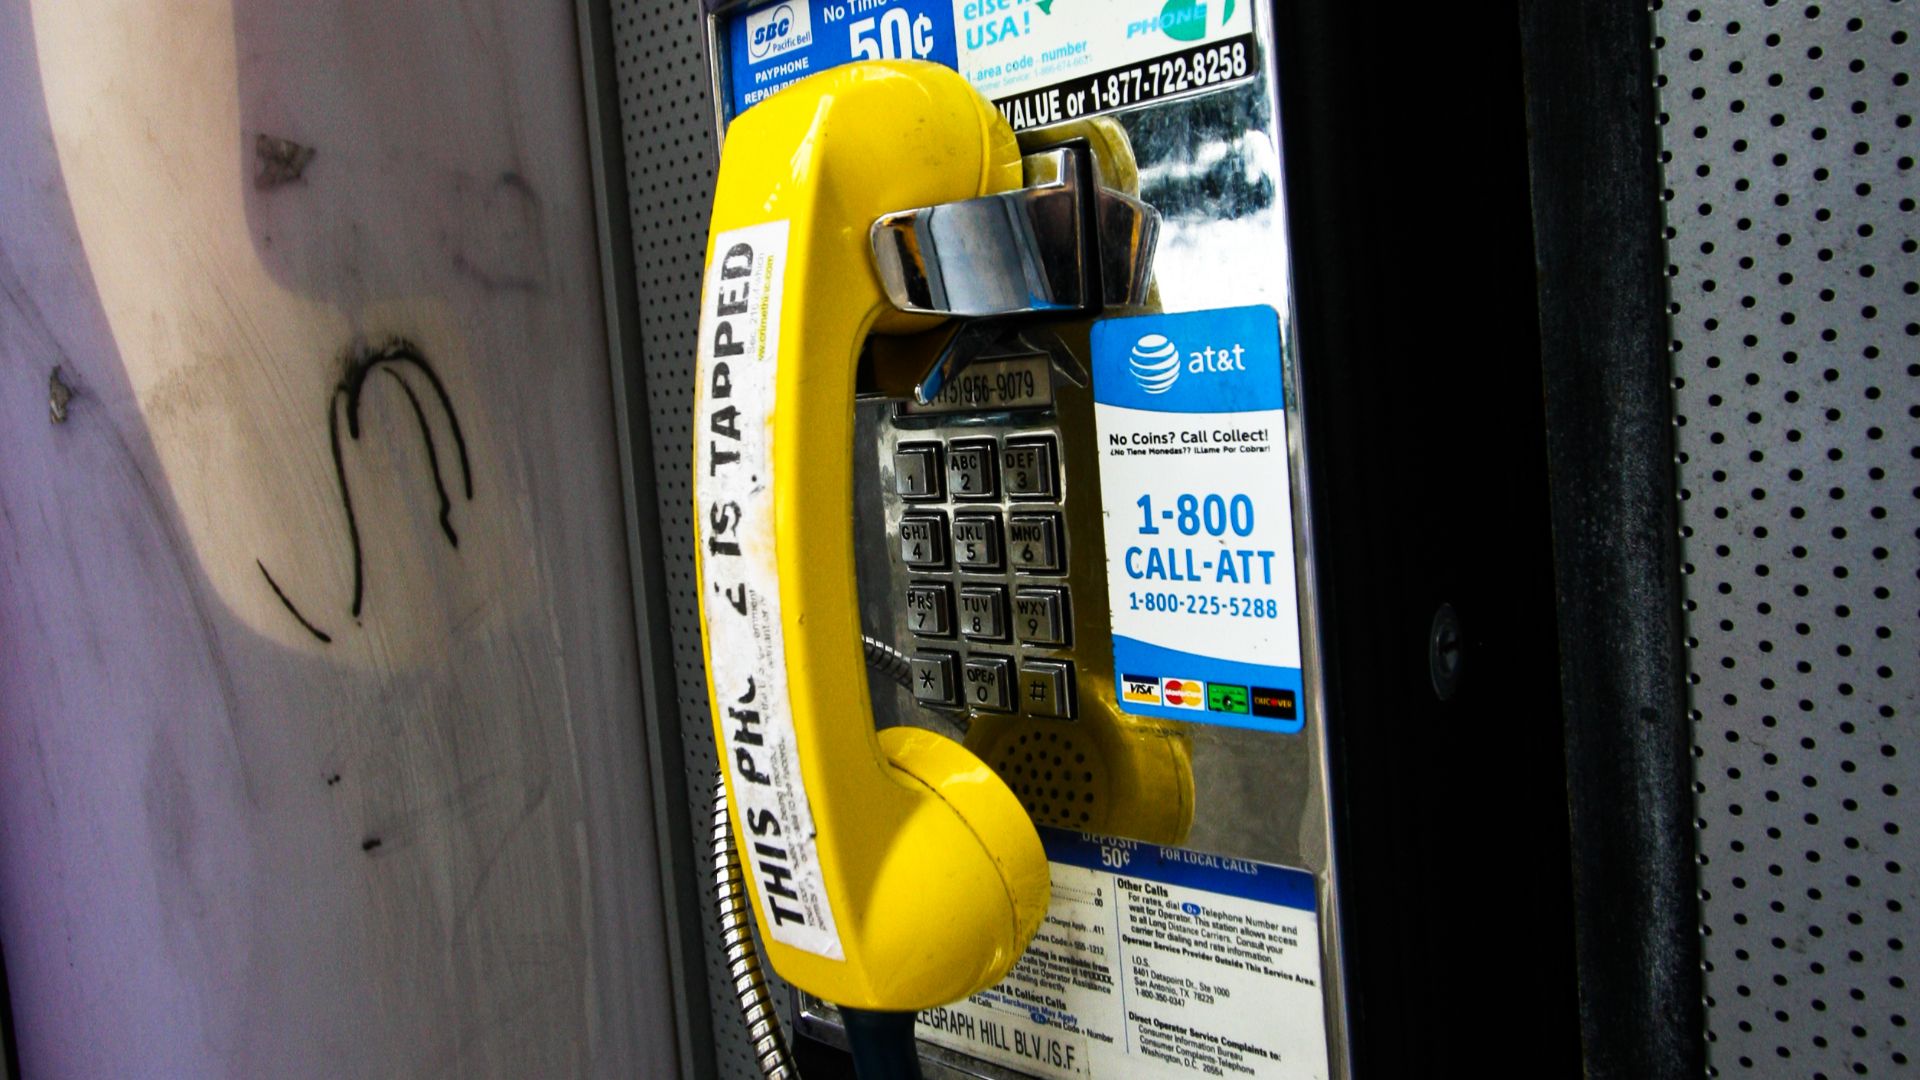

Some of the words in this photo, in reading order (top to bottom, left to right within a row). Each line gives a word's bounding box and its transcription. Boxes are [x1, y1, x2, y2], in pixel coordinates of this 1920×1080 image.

[823, 5, 845, 24] No
[964, 0, 1010, 20] else
[1127, 3, 1206, 39] PHONE
[754, 18, 789, 45] SBC
[773, 37, 796, 52] Pacific
[797, 31, 811, 45] Bell
[849, 7, 934, 60] 50¢
[755, 56, 809, 84] PAYPHONE
[977, 65, 1002, 81] area
[1005, 55, 1033, 72] code
[1041, 40, 1087, 62] number
[1000, 89, 1061, 131] VALUE
[1067, 91, 1086, 117] or
[1091, 42, 1247, 111] 1-877-722-8258
[710, 242, 754, 477] TAPPED
[1188, 343, 1246, 374] at&t
[1109, 433, 1127, 446] No
[1132, 431, 1176, 445] Coins?
[1180, 430, 1208, 444] Call
[1212, 428, 1269, 443] Collect!
[1005, 452, 1035, 468] DEF
[1127, 447, 1146, 456] Tiene
[1223, 445, 1236, 454] Por
[951, 454, 977, 471] ABC
[906, 474, 914, 490] 1
[961, 474, 971, 491] 2
[1017, 472, 1027, 488] 3
[1137, 493, 1254, 537] 1-800
[901, 525, 928, 540] GHI
[956, 526, 983, 541] JKL
[1011, 525, 1041, 542] MNO
[912, 543, 922, 559] 4
[966, 543, 976, 560] 5
[1022, 546, 1034, 562] 6
[1125, 547, 1275, 585] CALL-ATT
[907, 590, 933, 610] PRS
[963, 598, 988, 612] TUV
[1017, 600, 1048, 617] WXY
[1129, 592, 1278, 619] 1-800-225-5288
[917, 612, 926, 629] 7
[972, 617, 981, 633] 8
[1027, 619, 1038, 636] 9
[967, 668, 995, 685] OPER
[1130, 683, 1153, 695] VISA
[747, 807, 805, 925] THIS
[1102, 846, 1131, 869] 50¢
[1160, 848, 1181, 861] FOR
[1183, 852, 1219, 869] LOCAL
[1222, 858, 1258, 876] CALLS
[1117, 878, 1142, 892] Other
[1144, 883, 1169, 897] Calls
[1128, 892, 1140, 902] For
[1165, 900, 1180, 910] dial
[1202, 906, 1243, 923] Telephone
[1245, 915, 1279, 930] Number
[1282, 925, 1298, 936] and
[1129, 904, 1145, 913] wait
[1146, 905, 1156, 916] for
[1194, 915, 1211, 928] This
[1212, 920, 1239, 934] station
[1240, 926, 1266, 939] allows
[1268, 933, 1298, 946] access
[1129, 914, 1137, 923] to
[1138, 915, 1147, 925] all
[1149, 918, 1167, 931] Long
[1168, 921, 1199, 936] Distance
[1201, 928, 1232, 943] Carriers.
[1236, 936, 1265, 950] Consult
[1266, 944, 1283, 955] your
[1131, 925, 1153, 936] carrier
[1155, 929, 1166, 940] for
[1167, 932, 1192, 947] dialing
[1194, 939, 1208, 950] and
[1210, 942, 1225, 953] rate
[1227, 946, 1274, 964] information.
[1122, 934, 1152, 948] Operator
[1154, 941, 1181, 955] Service
[1182, 947, 1213, 962] Provider
[1214, 953, 1243, 969] Outside
[1245, 961, 1262, 974] This
[1263, 966, 1293, 982] Service
[1041, 968, 1071, 983] Operator
[1150, 969, 1184, 986] Datapoint
[1199, 982, 1212, 993] Ste
[1213, 985, 1231, 998] 1000
[1134, 976, 1148, 987] San
[1180, 988, 1190, 999] TX
[1006, 985, 1013, 996] &
[1015, 987, 1044, 1004] Collect
[1045, 996, 1067, 1011] Calls
[1057, 1010, 1078, 1025] Apply
[916, 1006, 975, 1040] LEGRAPH
[980, 1019, 1010, 1051] HILL
[1063, 1022, 1080, 1034] Code
[1087, 1029, 1114, 1043] Number
[1128, 1011, 1152, 1026] Direct
[1153, 1017, 1187, 1035] Operator
[1189, 1027, 1219, 1044] Service
[1221, 1036, 1268, 1057] Complaints
[1138, 1024, 1173, 1040] Consumer
[1174, 1034, 1216, 1053] Information
[1217, 1046, 1243, 1061] Bureau
[1139, 1034, 1174, 1052] Consumer
